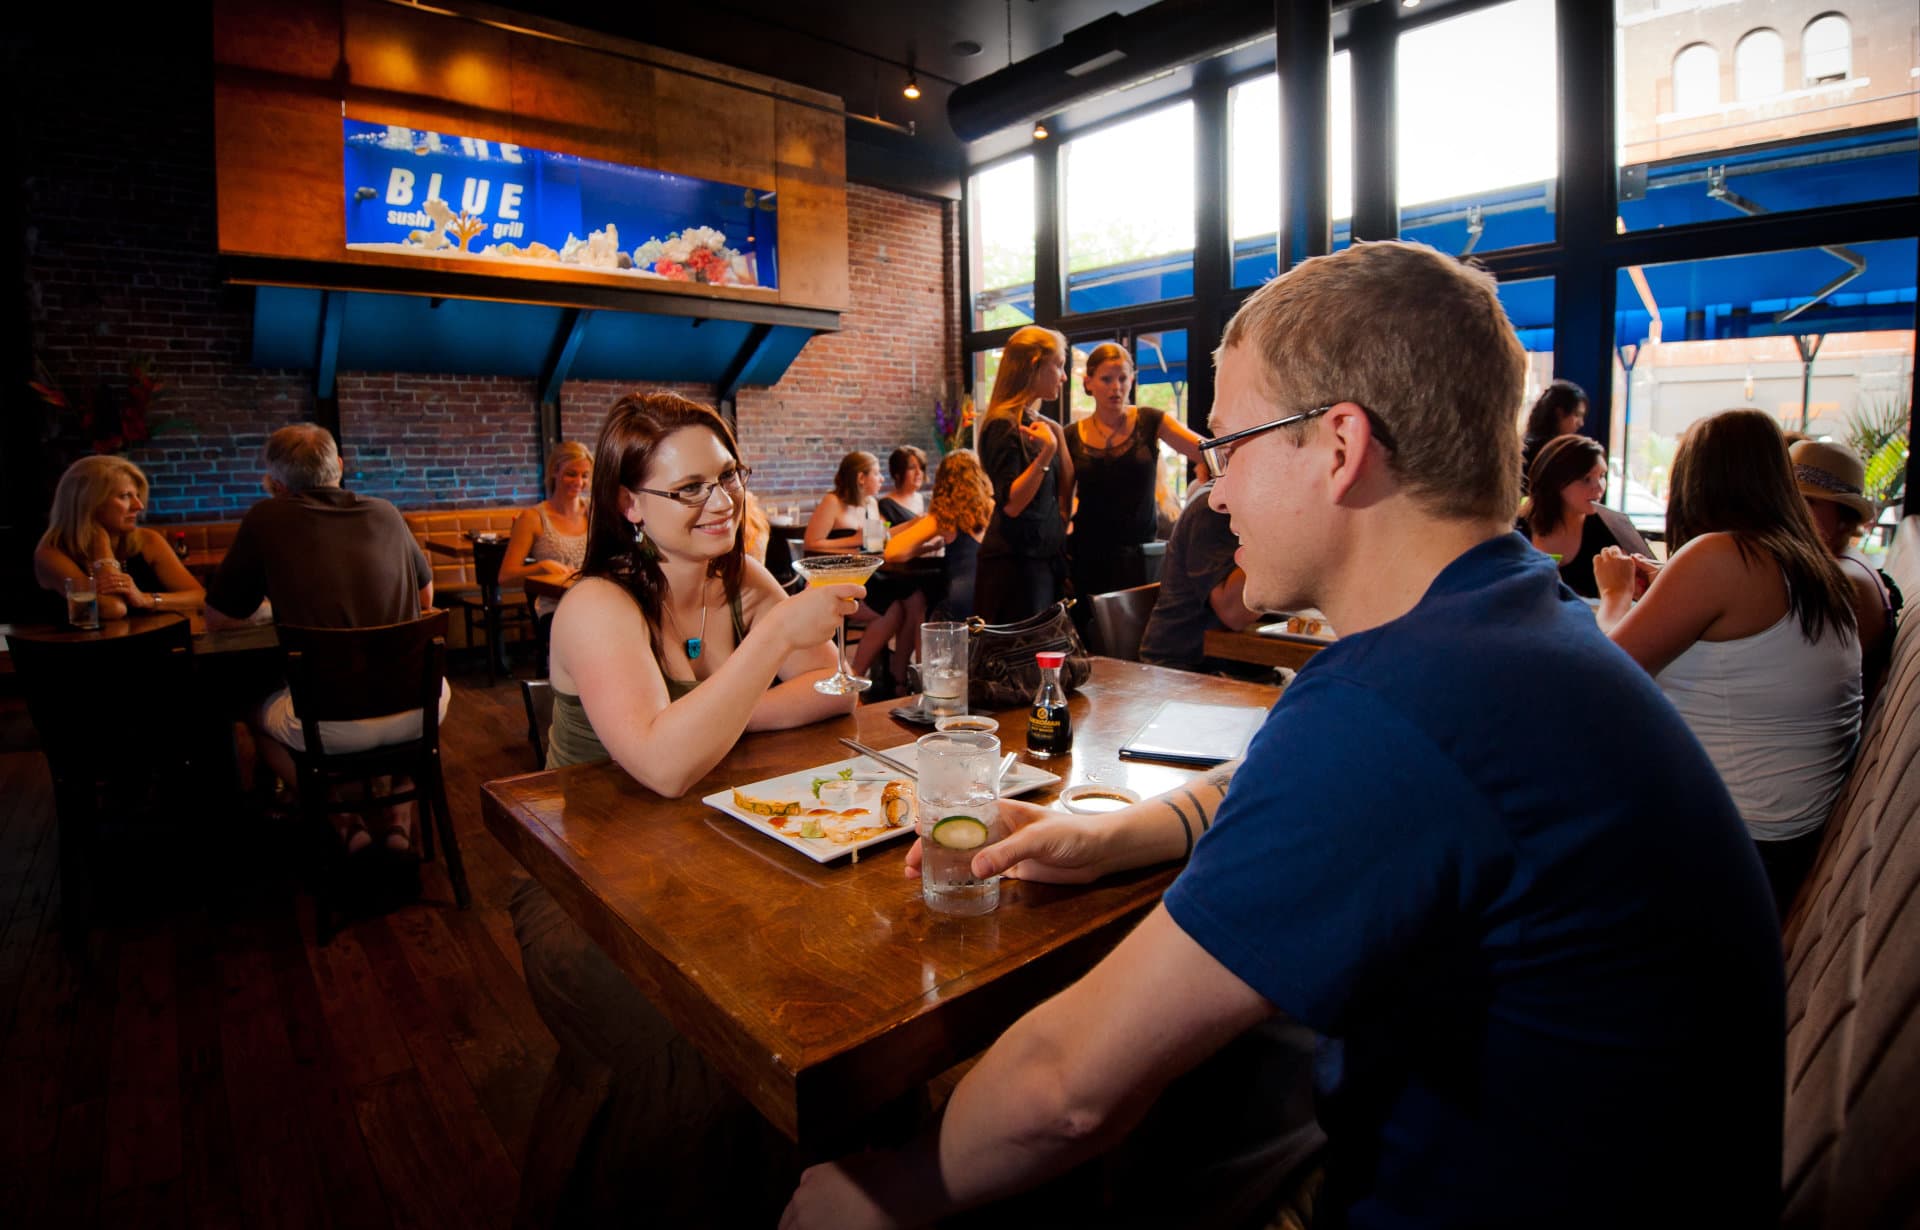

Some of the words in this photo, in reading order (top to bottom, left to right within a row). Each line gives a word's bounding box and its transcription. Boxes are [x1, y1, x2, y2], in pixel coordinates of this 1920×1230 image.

[385, 167, 524, 219] BLUE
[386, 210, 432, 227] sushi
[492, 221, 525, 239] grill
